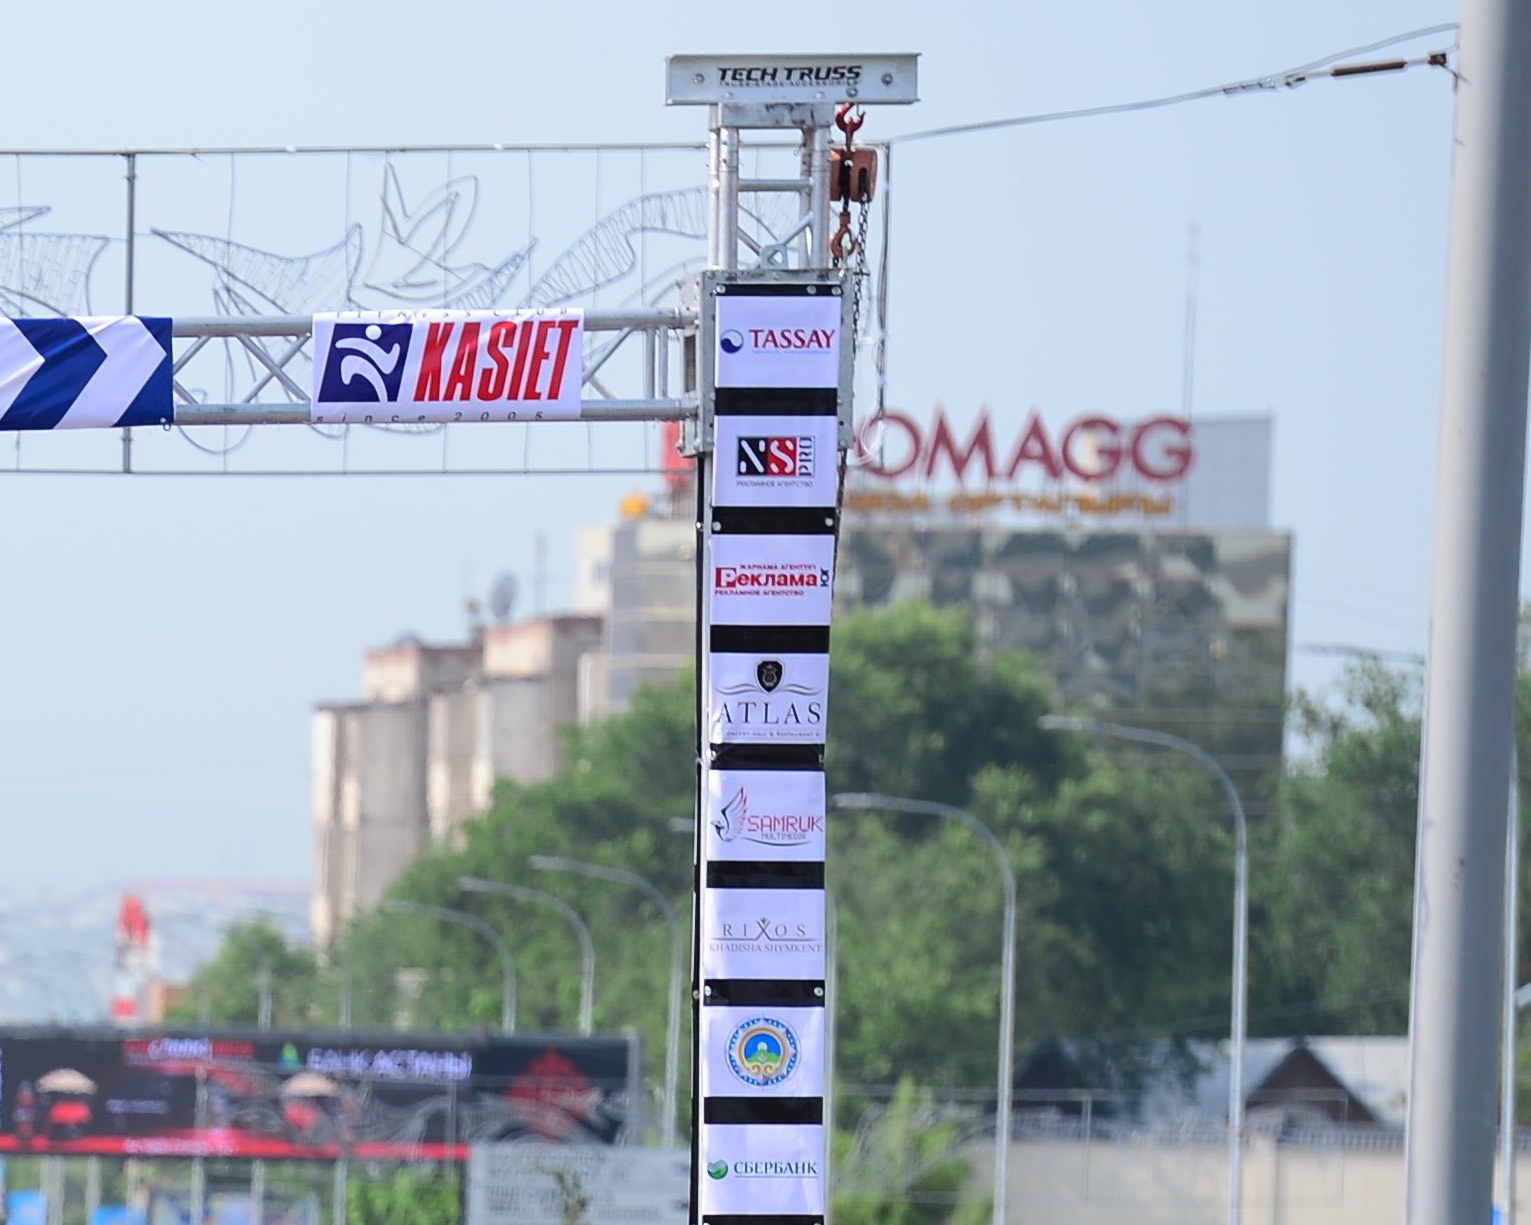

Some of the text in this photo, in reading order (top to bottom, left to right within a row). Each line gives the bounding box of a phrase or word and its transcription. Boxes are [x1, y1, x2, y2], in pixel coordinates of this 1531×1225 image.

[717, 65, 862, 81] TECH TRUSS
[748, 329, 836, 350] TASSAY
[412, 318, 580, 402] KASIET
[715, 566, 819, 588] Реклама
[717, 701, 822, 725] ATLAS
[747, 815, 823, 833] SAMRUK
[722, 918, 807, 939] RIXOS
[764, 943, 822, 953] SHYMKENT
[733, 1161, 818, 1175] СБЕРБАНК
